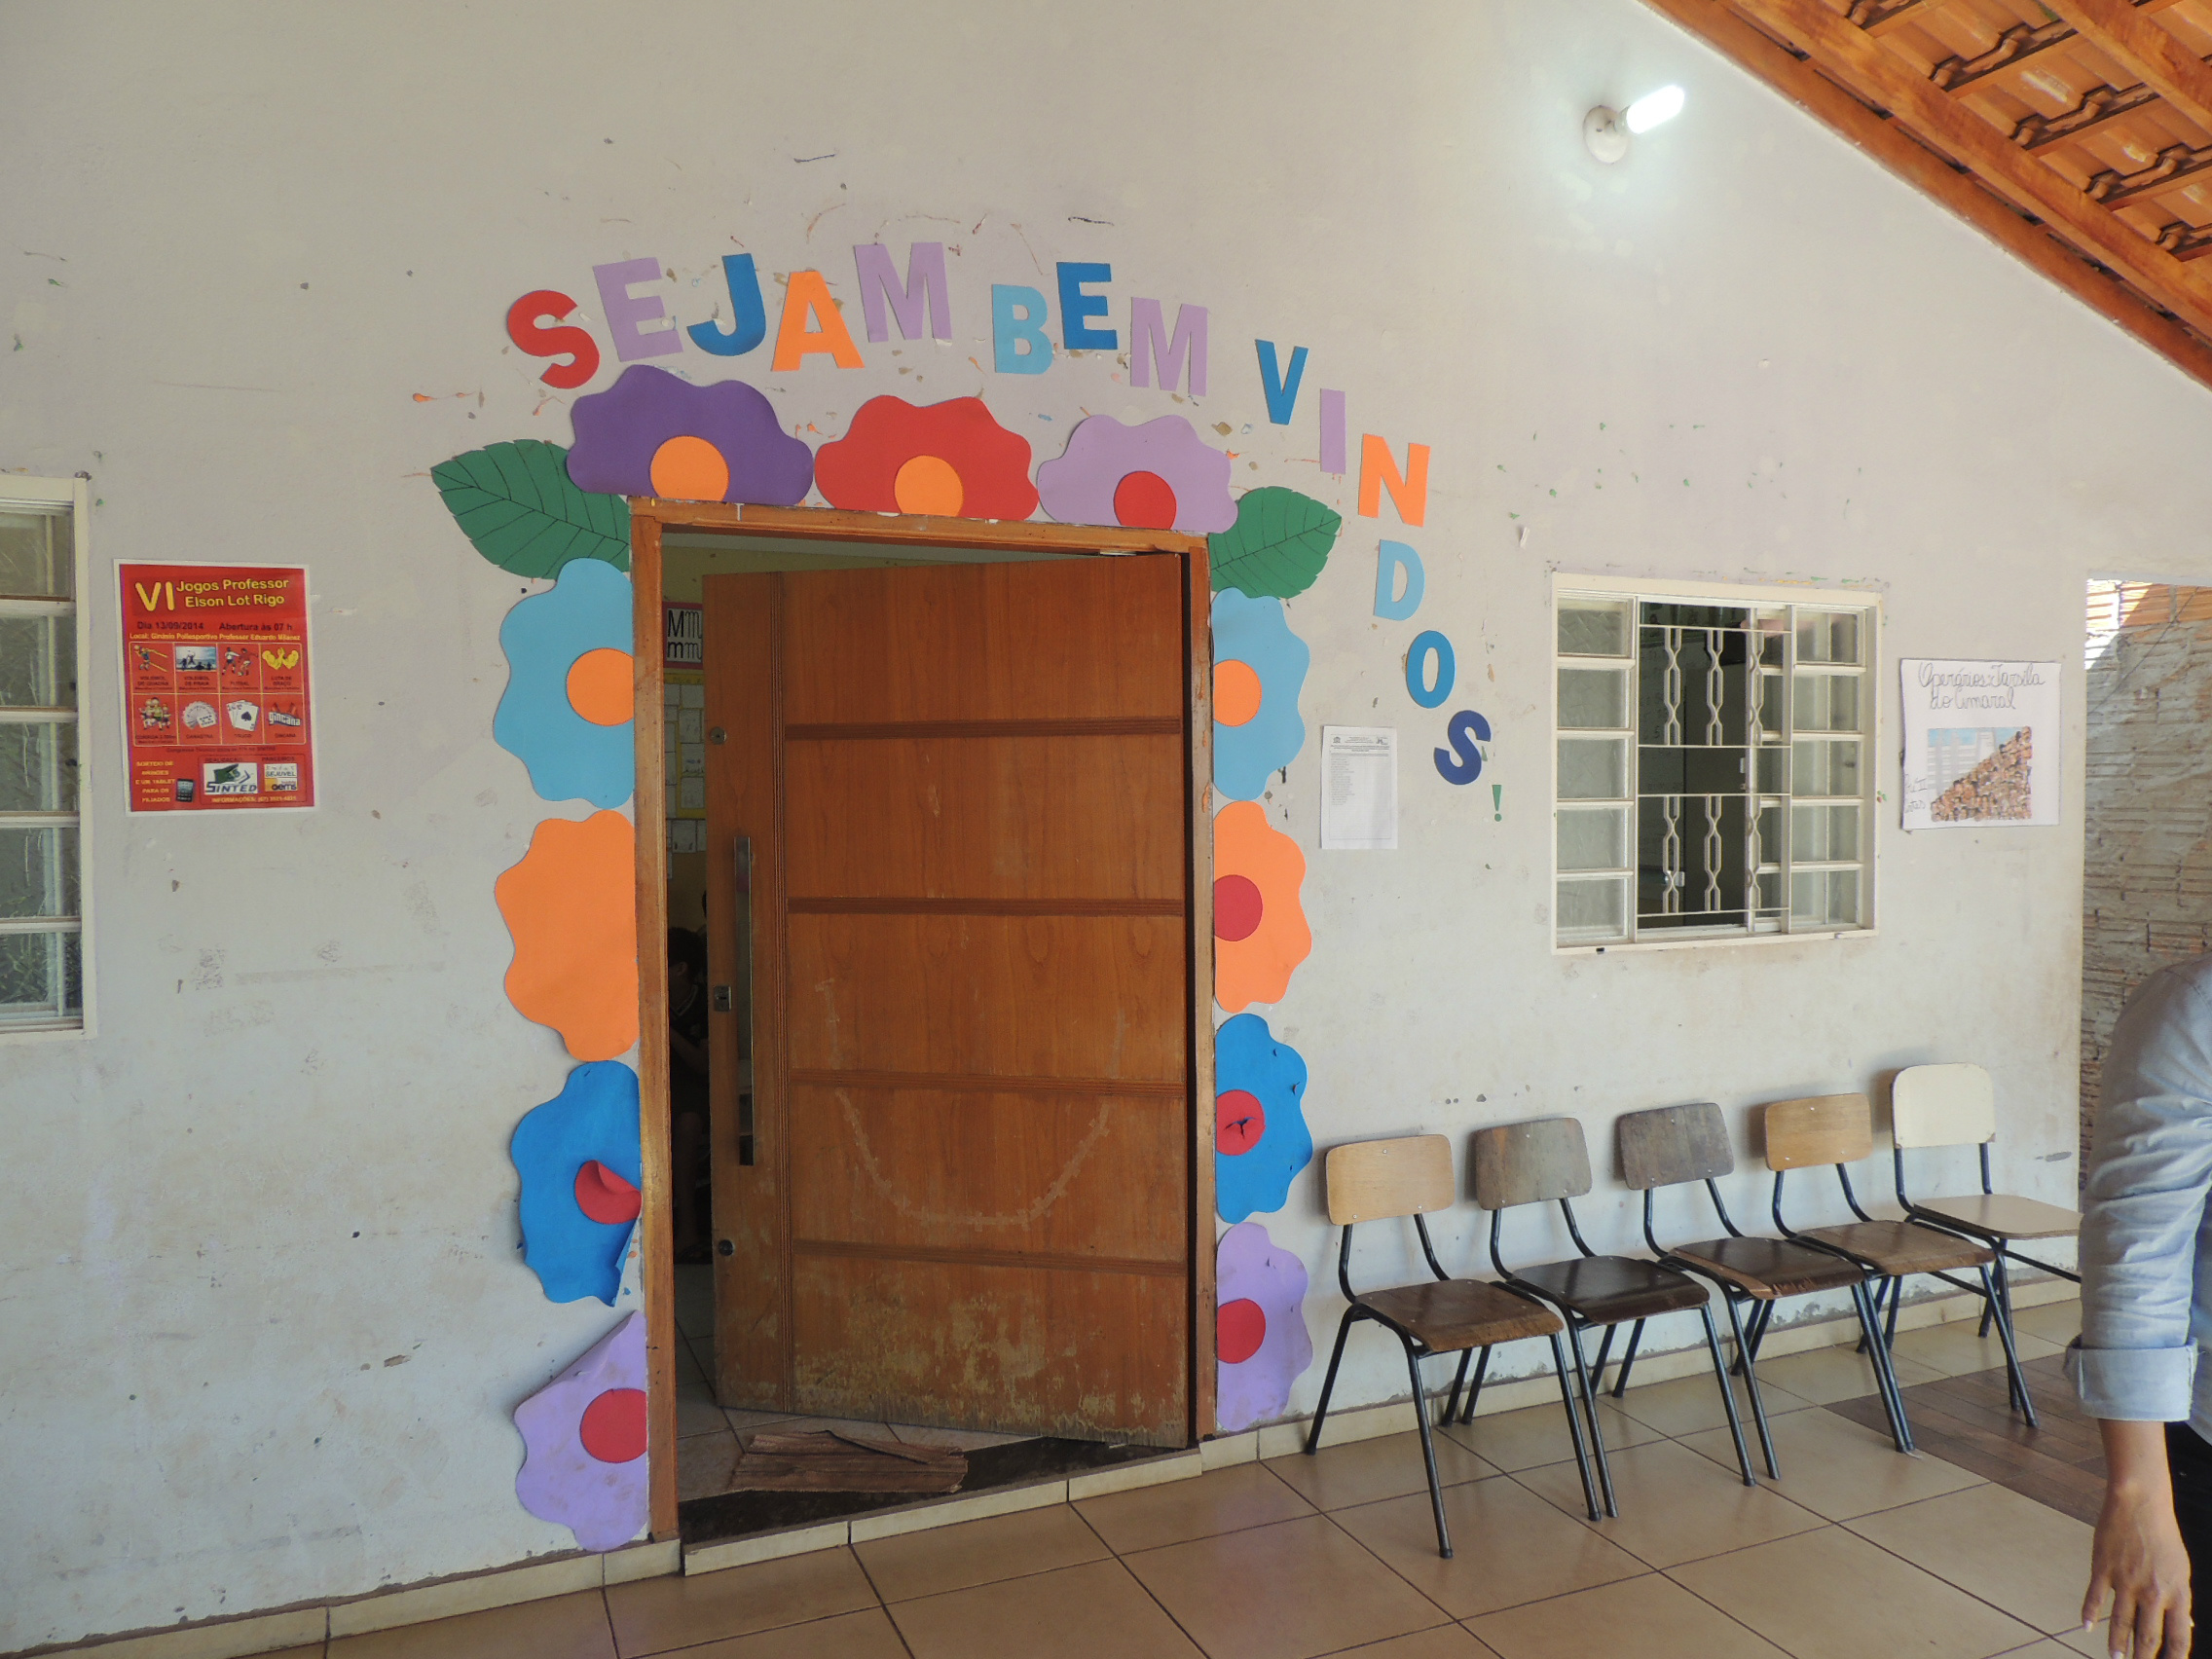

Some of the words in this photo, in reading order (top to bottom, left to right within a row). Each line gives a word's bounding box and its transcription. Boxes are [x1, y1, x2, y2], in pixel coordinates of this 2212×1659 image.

[506, 241, 952, 388] SEJAM
[991, 262, 1208, 397] BEM
[176, 581, 219, 593] Jogos
[223, 578, 289, 590] Professor
[134, 581, 175, 611] VI
[185, 596, 223, 608] Elson
[228, 595, 250, 606] Lot
[253, 594, 284, 608] Rigo
[137, 621, 152, 630] Dia
[156, 621, 204, 630] 13/09/2014
[1954, 685, 2016, 710] Amaral
[205, 781, 257, 793] SINTED
